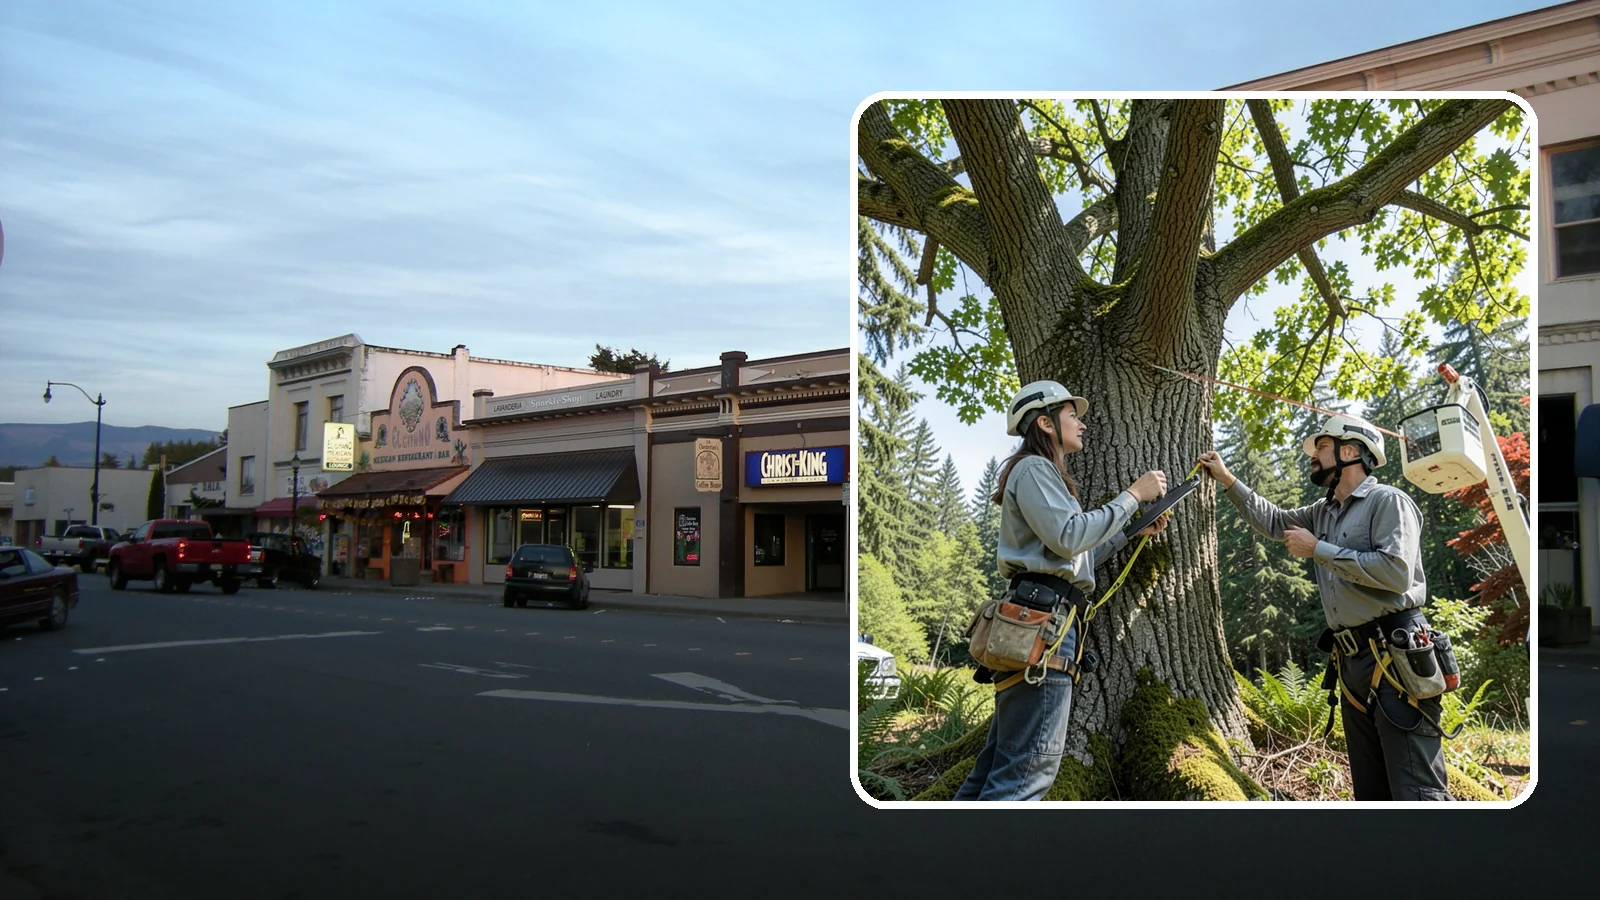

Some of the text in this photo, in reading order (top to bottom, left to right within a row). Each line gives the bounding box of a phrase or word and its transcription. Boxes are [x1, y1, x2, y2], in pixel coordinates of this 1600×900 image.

[493, 388, 624, 413] LAVANDERIA Sparkle Shop LAUNDRY
[373, 455, 396, 464] MEXICAN
[397, 452, 433, 463] RESTAURANT
[438, 450, 450, 459] BAR
[696, 481, 722, 489] Coffee House
